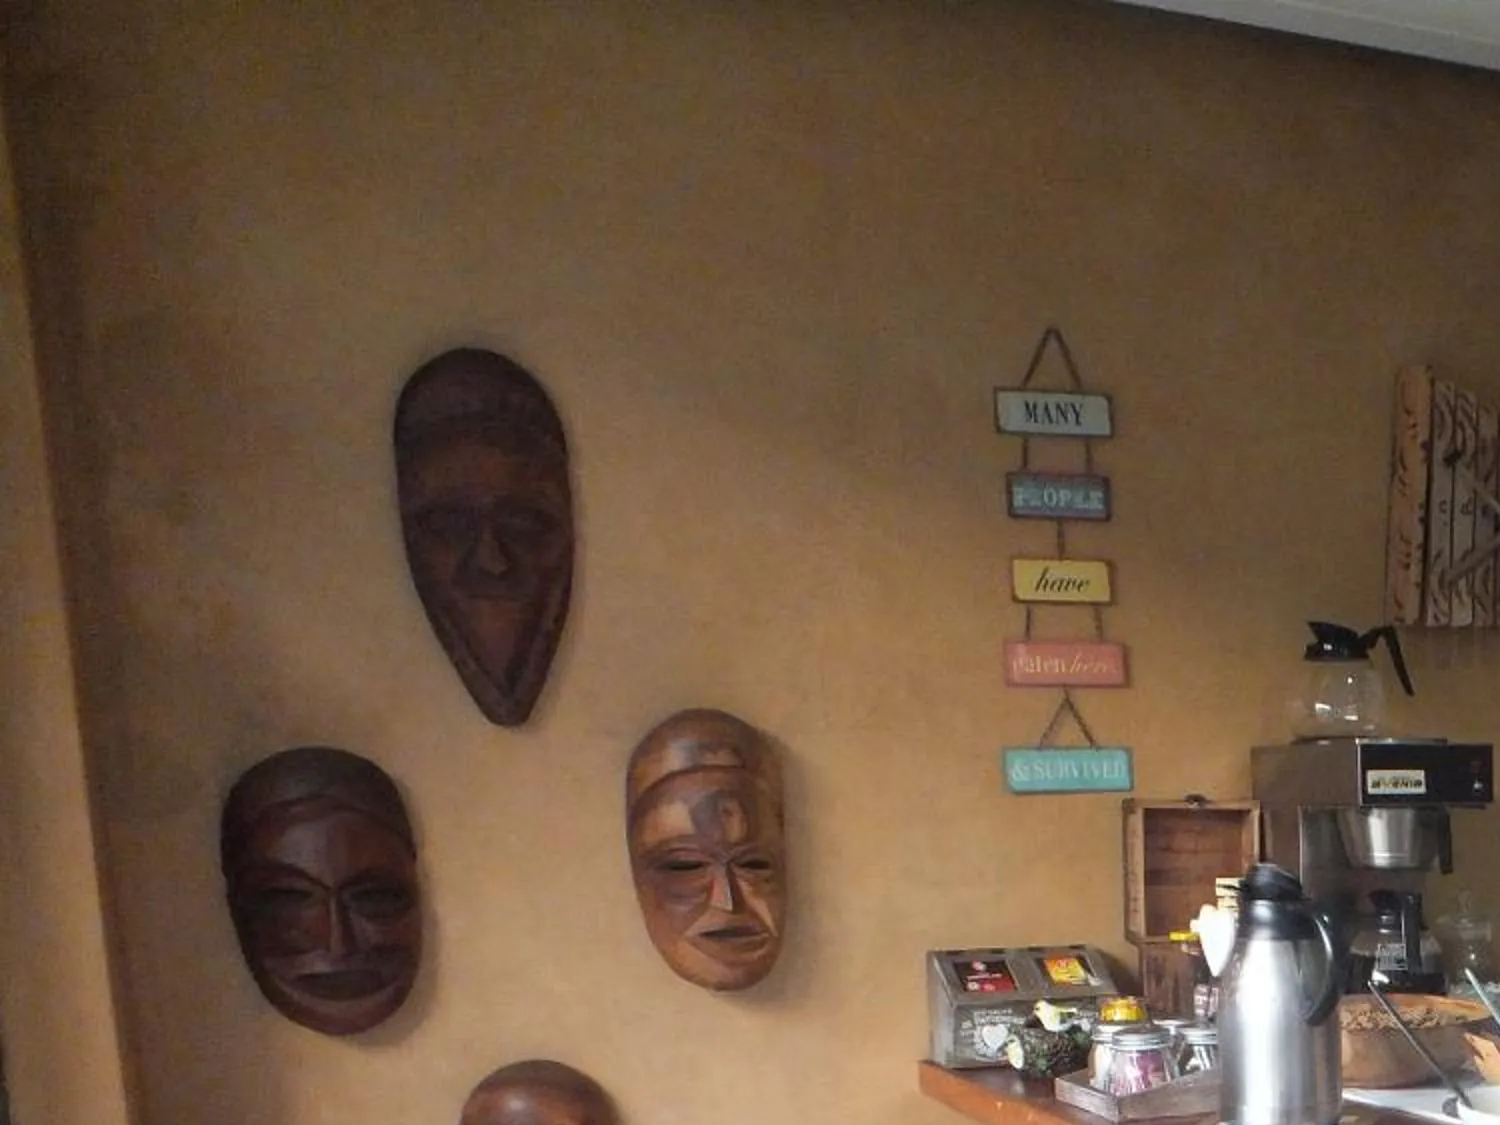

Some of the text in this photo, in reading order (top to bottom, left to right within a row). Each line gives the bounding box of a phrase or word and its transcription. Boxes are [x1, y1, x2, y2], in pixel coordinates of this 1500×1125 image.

[1023, 400, 1084, 427] MANY
[1034, 564, 1091, 594] have
[1011, 760, 1127, 784] & SURVIVED
